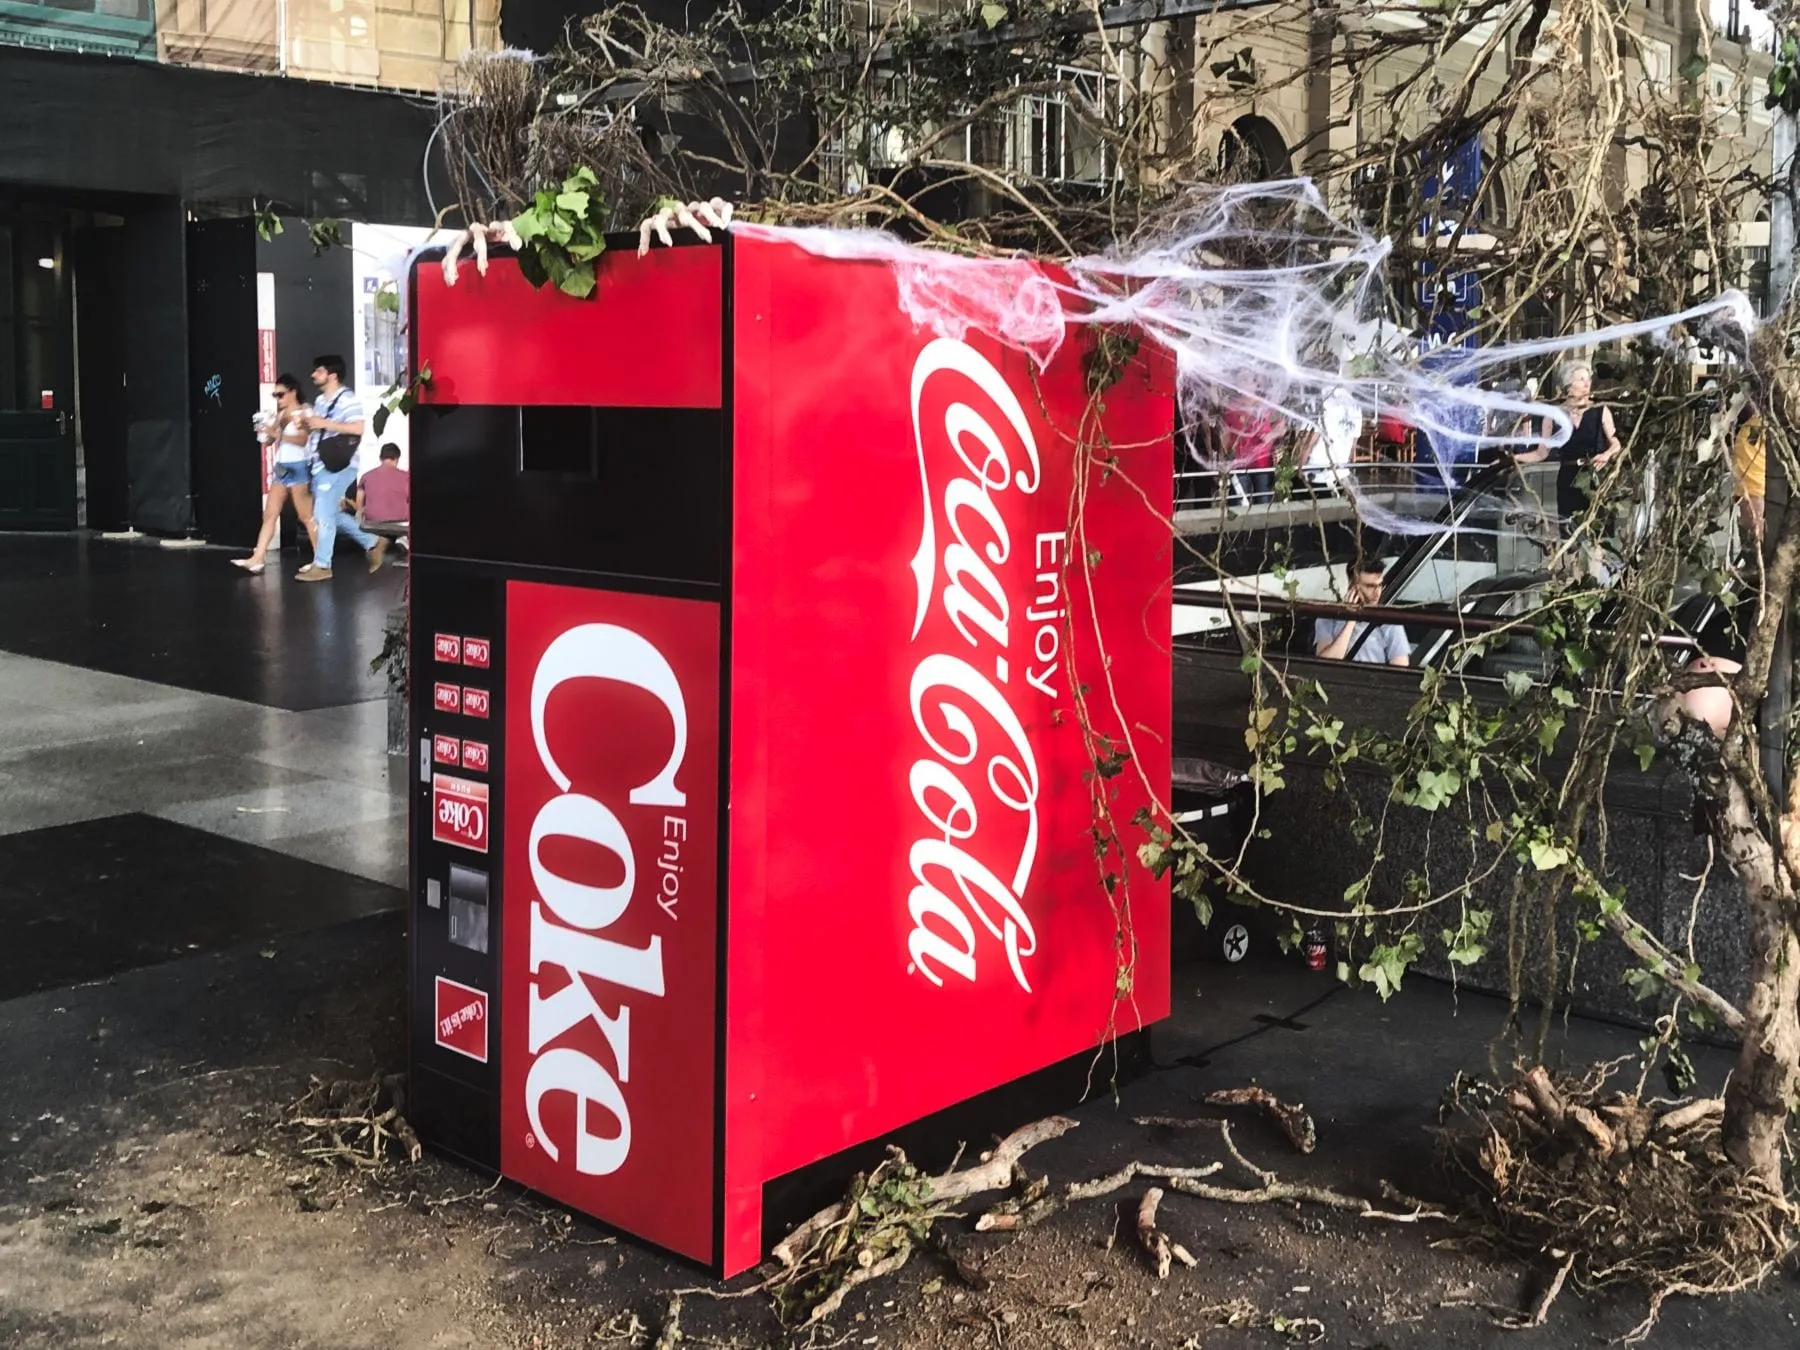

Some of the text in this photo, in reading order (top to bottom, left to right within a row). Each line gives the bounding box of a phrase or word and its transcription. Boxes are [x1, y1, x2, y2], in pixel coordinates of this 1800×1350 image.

[1026, 531, 1069, 698] Enjoy
[437, 638, 459, 659] Coke
[465, 643, 488, 663] Coke
[908, 336, 1040, 993] Coca-Cola
[437, 688, 459, 708] Coke
[465, 692, 488, 713] Coke
[436, 740, 458, 761] Coke
[464, 744, 487, 766] Coke
[438, 798, 484, 841] Coke
[656, 815, 686, 920] Enjoy
[526, 623, 688, 1176] Coke
[450, 1011, 463, 1030] is
[459, 1000, 484, 1023] Coke
